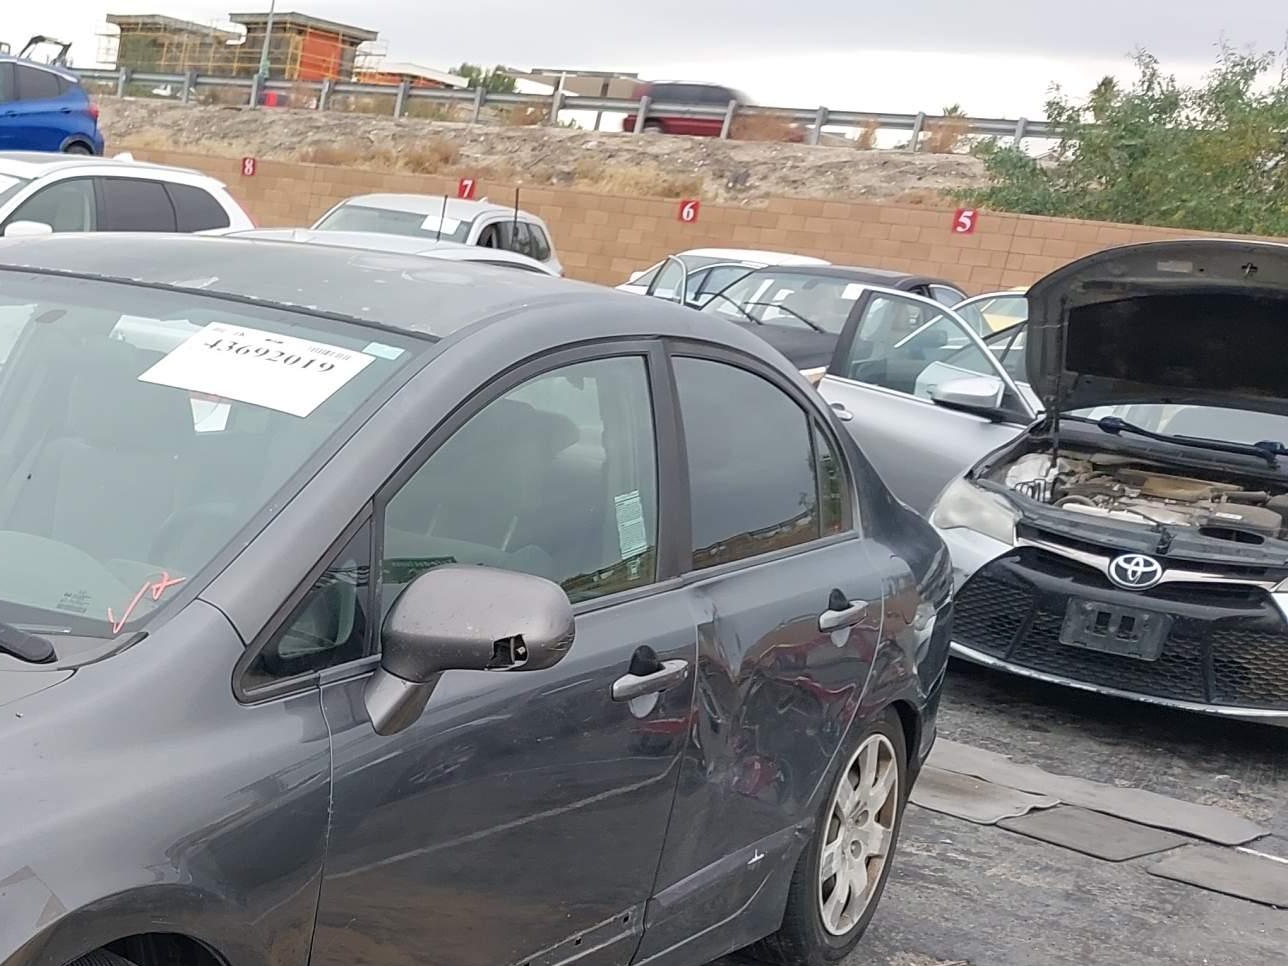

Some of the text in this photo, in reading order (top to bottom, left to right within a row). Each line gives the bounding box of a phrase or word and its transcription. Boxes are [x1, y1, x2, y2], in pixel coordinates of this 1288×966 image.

[244, 158, 254, 175] 8
[462, 179, 473, 198] 7
[682, 201, 696, 221] 6
[956, 210, 974, 232] 5
[203, 338, 336, 374] 43692019
